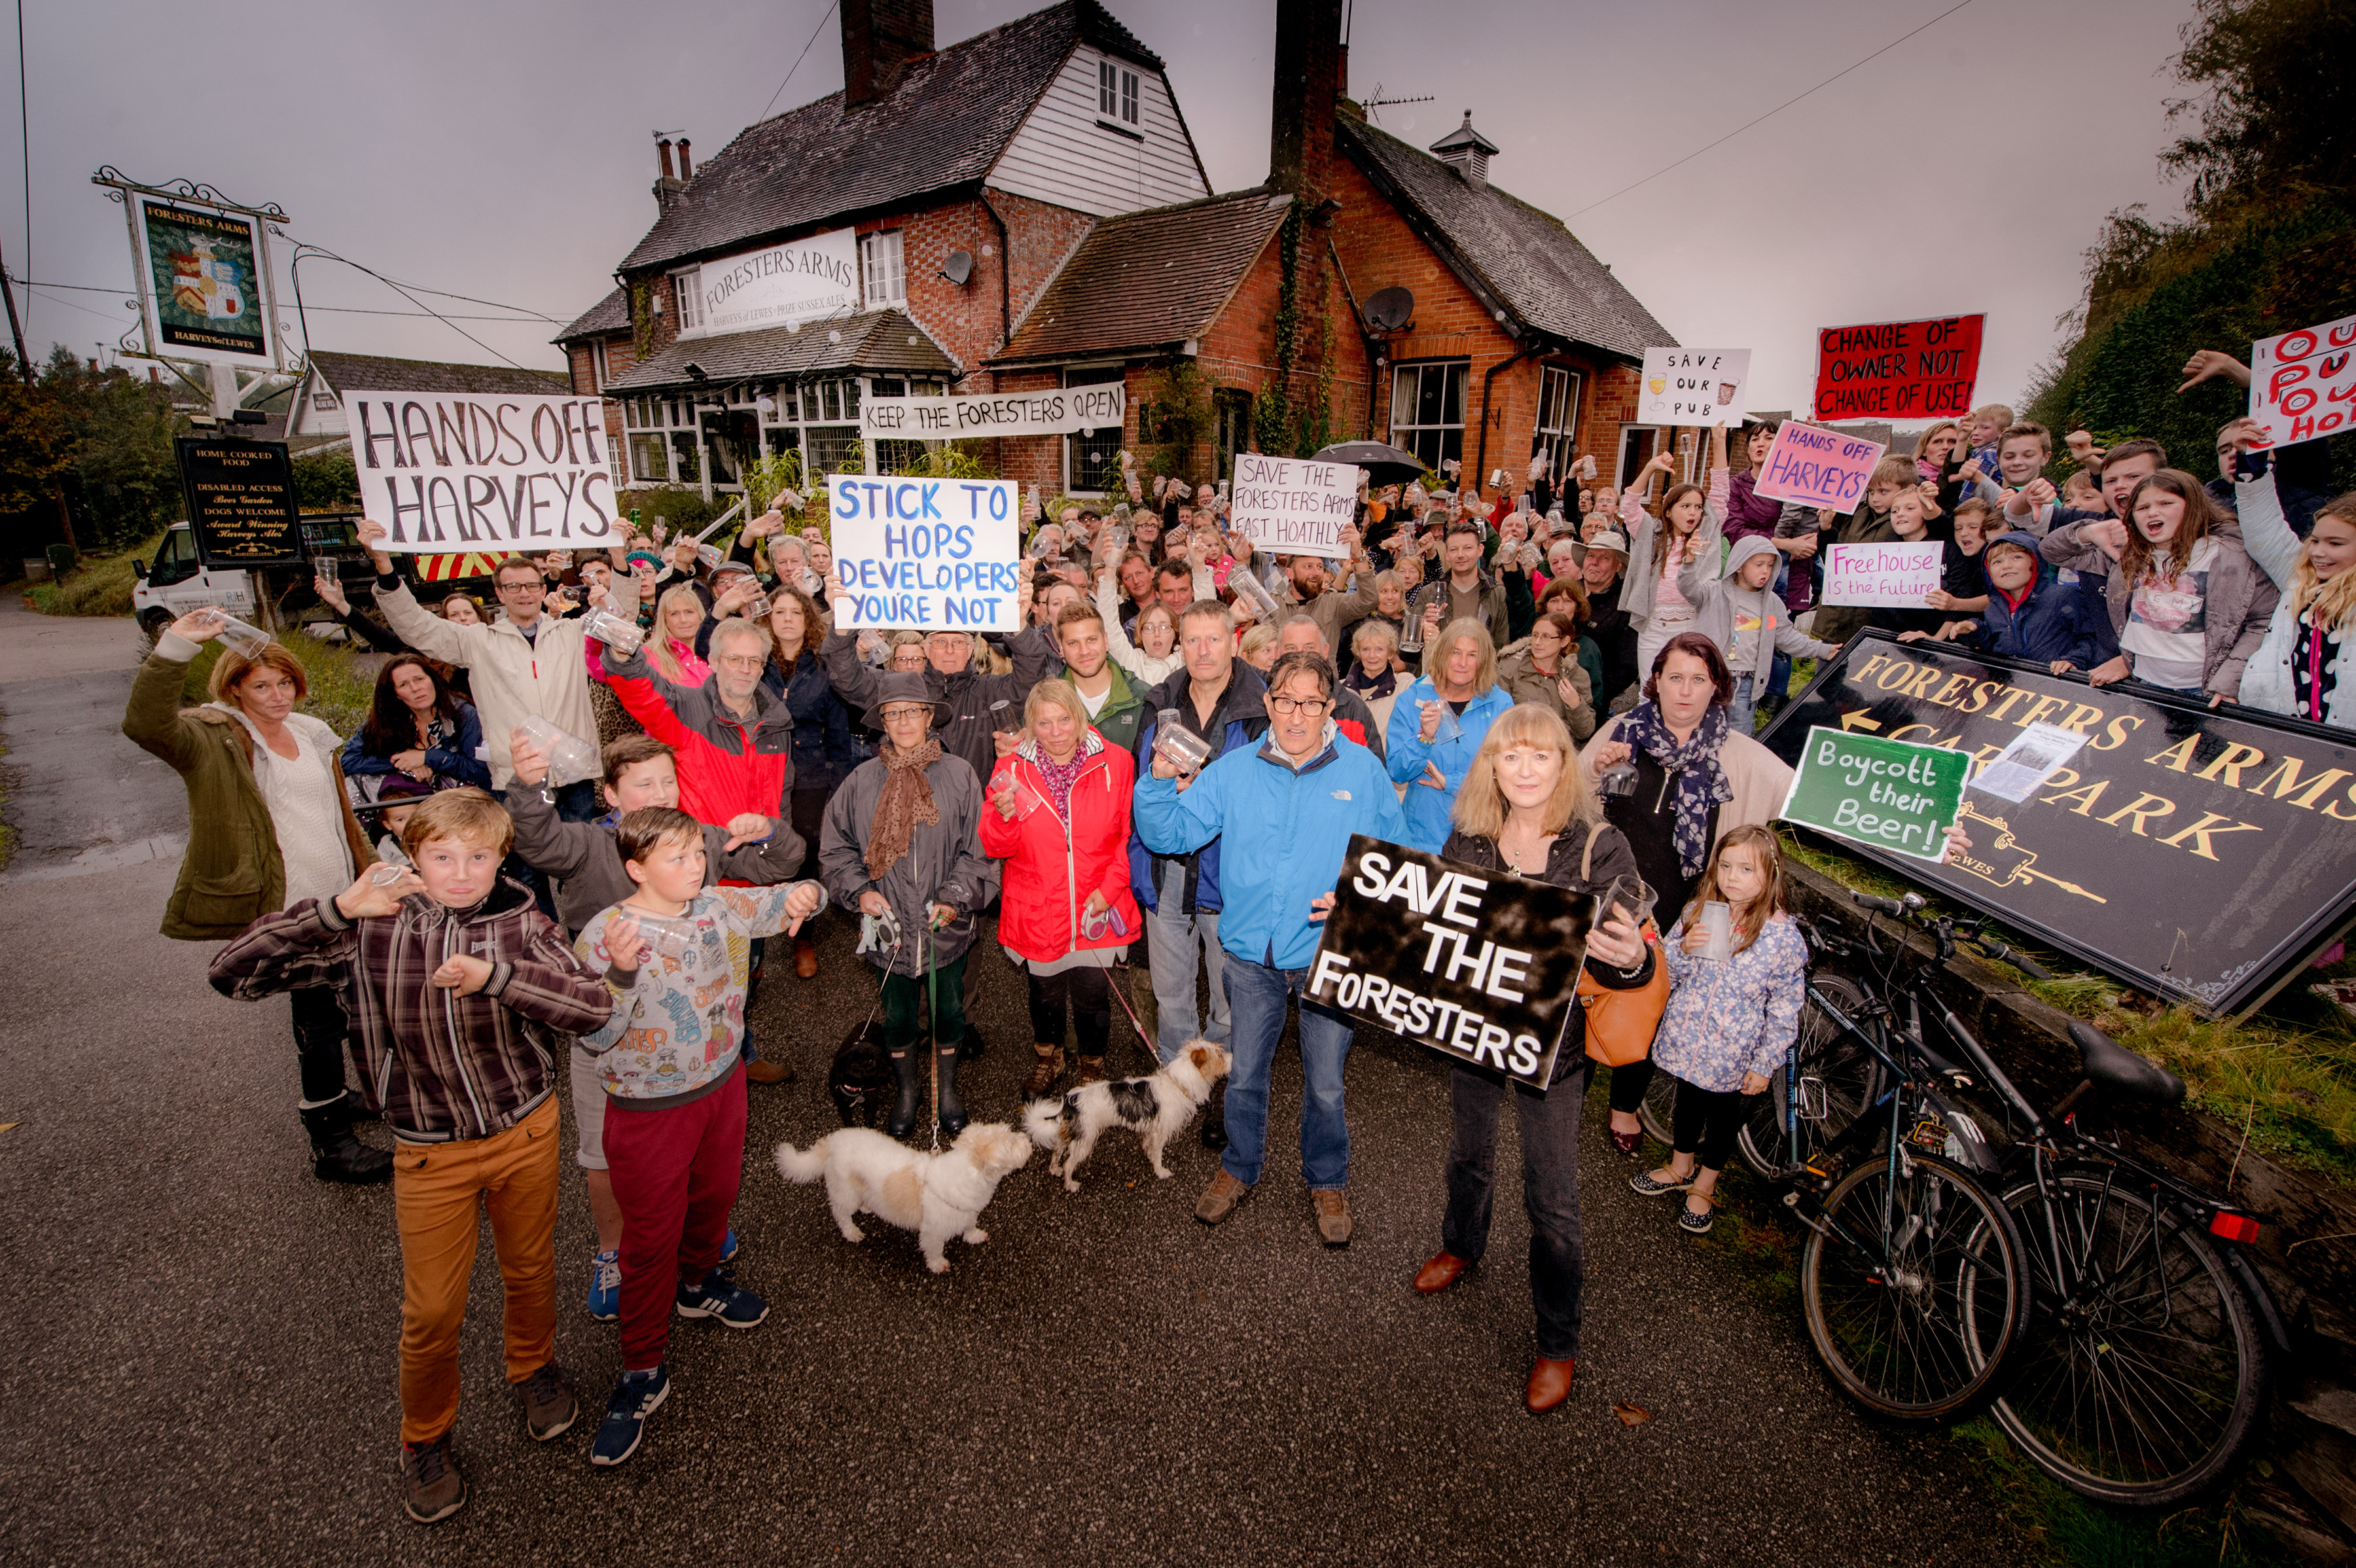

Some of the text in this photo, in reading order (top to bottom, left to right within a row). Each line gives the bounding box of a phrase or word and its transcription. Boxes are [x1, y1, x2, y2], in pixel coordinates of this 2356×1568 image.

[147, 206, 249, 235] FORESTERS ARMS
[705, 249, 852, 314] FORESTERS ARMS
[713, 294, 845, 327] HARVEYS of LEWES PRIZE SUSSEX ALES
[174, 331, 217, 344] HARVEYS
[224, 338, 255, 349] LEWES
[1823, 320, 1959, 353] CHANGE OF
[2275, 321, 2356, 362] OU
[1668, 354, 1721, 370] SAVE
[1831, 350, 1965, 382] OWNER NOT
[1677, 378, 1709, 390] OUR
[1818, 381, 1972, 414] CHANGE OF USE!
[866, 387, 1120, 429] KEEP THE FORESTERS OPEN
[1674, 402, 1711, 416] PUB
[358, 400, 601, 468] HANDS OFF
[1787, 429, 1874, 461] HANDS OFF
[1242, 459, 1336, 487] SAVE THE
[1768, 450, 1866, 499] HARVEY'S
[240, 495, 273, 504] Garden
[385, 469, 610, 543] HARVEY'S
[836, 480, 1008, 521] STICK TO
[1235, 487, 1354, 517] FORESTERS ARMS
[217, 529, 282, 540] Harveys Ales
[247, 515, 288, 531] Winning
[1277, 518, 1344, 544] HOATHLY
[885, 523, 975, 559] HOPS
[838, 558, 1020, 593] DEVELOPERS
[1834, 546, 1934, 575] Freehouse
[226, 591, 245, 602] RJH
[1849, 580, 1874, 594] the
[945, 597, 1002, 624] NOT
[1849, 654, 2145, 750] FORESTERS
[1817, 740, 1936, 786] Boycott
[1869, 781, 1934, 814] their
[1833, 798, 1937, 851] Beer!
[1353, 852, 1488, 927] SAVE
[1422, 921, 1533, 1003] THE
[1310, 950, 1541, 1077] FORESTERS
[1808, 988, 1855, 1031] ORACLE
